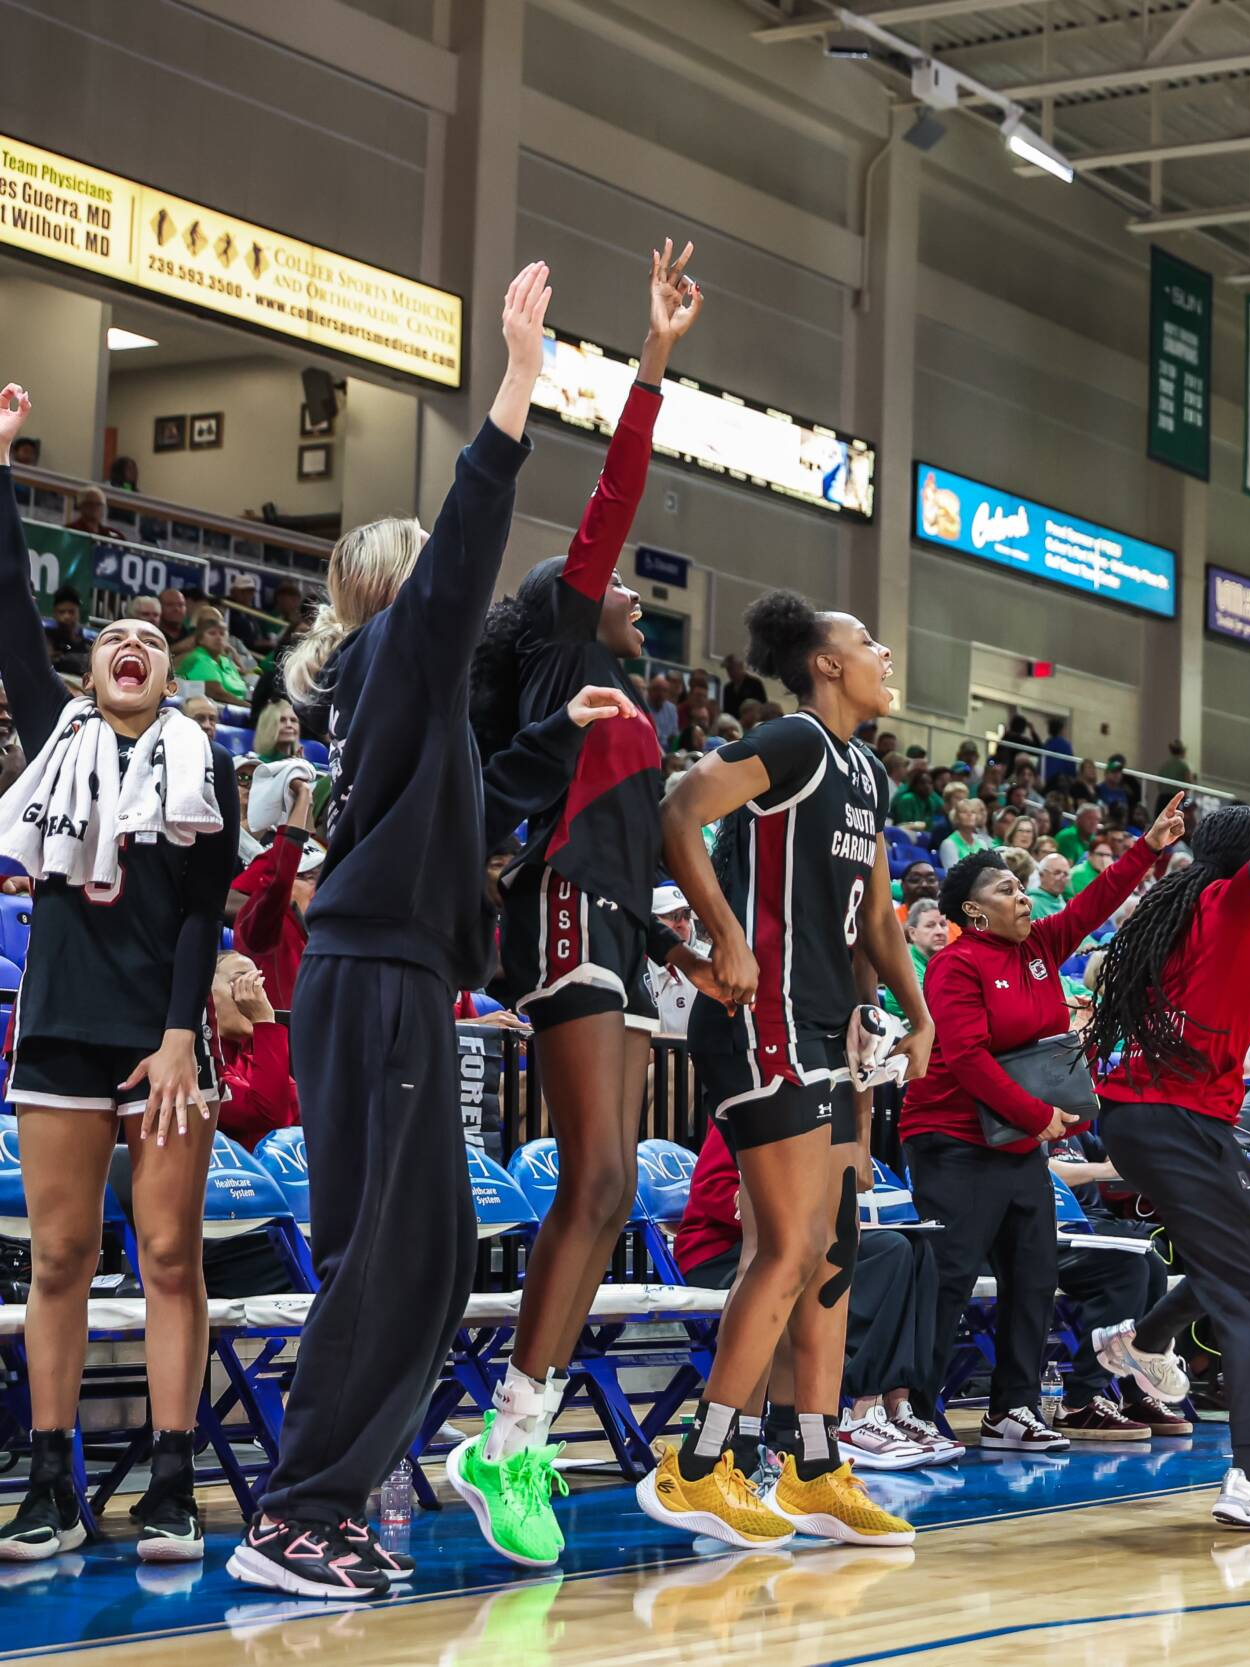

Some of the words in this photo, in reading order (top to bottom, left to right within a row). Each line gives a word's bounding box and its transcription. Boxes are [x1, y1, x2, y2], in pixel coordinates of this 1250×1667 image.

[3, 150, 38, 178] Team
[42, 165, 113, 203] Physicians
[22, 182, 81, 221] Guerra,
[87, 204, 111, 230] MD
[12, 206, 79, 249] Wilhoit,
[85, 231, 110, 257] MD
[338, 270, 388, 300] SPORTS
[406, 317, 456, 346] CENTER
[121, 554, 168, 597] QQ
[845, 802, 876, 836] SOUTH
[557, 880, 572, 959] USC
[843, 876, 864, 946] 8
[215, 1178, 251, 1189] Healthcare
[230, 1188, 255, 1200] System
[476, 1195, 501, 1206] System
